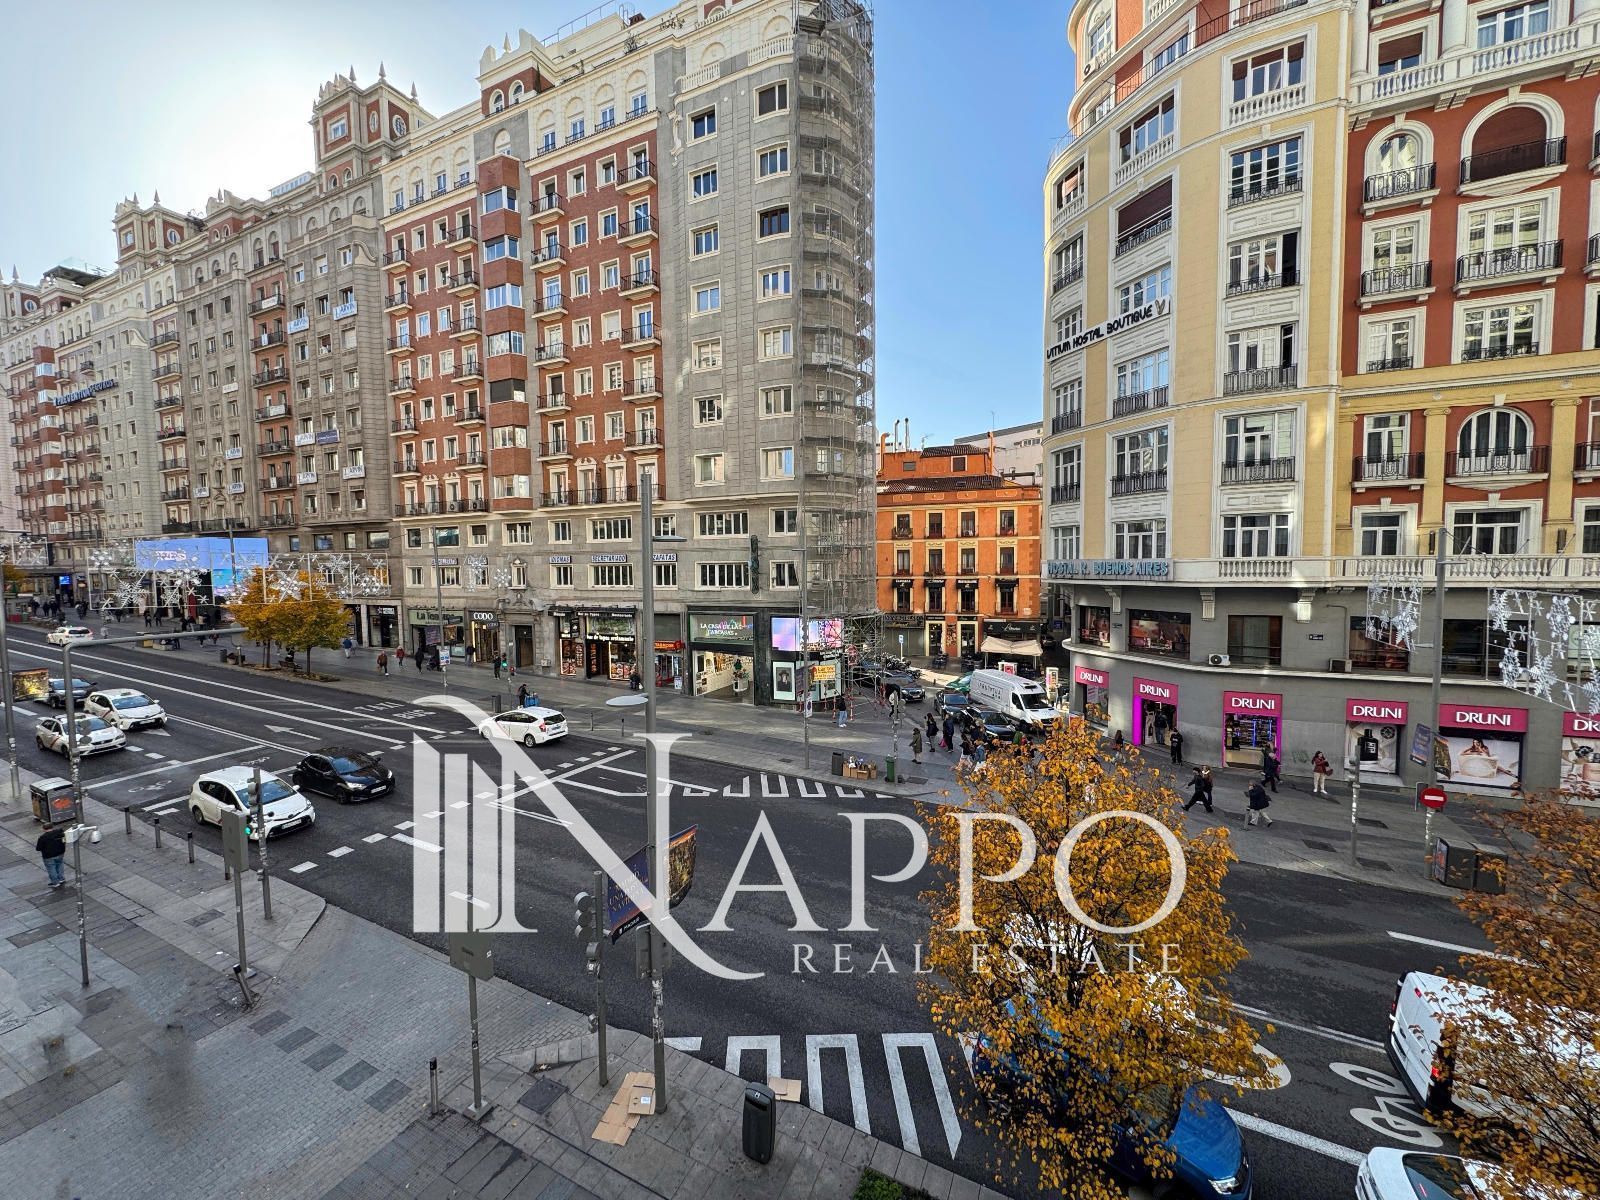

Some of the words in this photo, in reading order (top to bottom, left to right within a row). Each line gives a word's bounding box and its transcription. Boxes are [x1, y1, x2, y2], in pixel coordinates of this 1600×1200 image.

[1073, 326, 1104, 348] HOSTAL
[1106, 304, 1153, 334] BOUTIQUE
[1047, 562, 1078, 575] HOSTAL
[1093, 561, 1133, 576] BUENOS
[1135, 561, 1168, 576] AIRES
[473, 612, 494, 621] CODO
[1080, 671, 1104, 684] DRUNI
[1139, 683, 1170, 698] DRUNI
[1231, 697, 1275, 710] DRUNI
[1353, 705, 1402, 719] DRUNI
[1455, 711, 1512, 726] DRUNI
